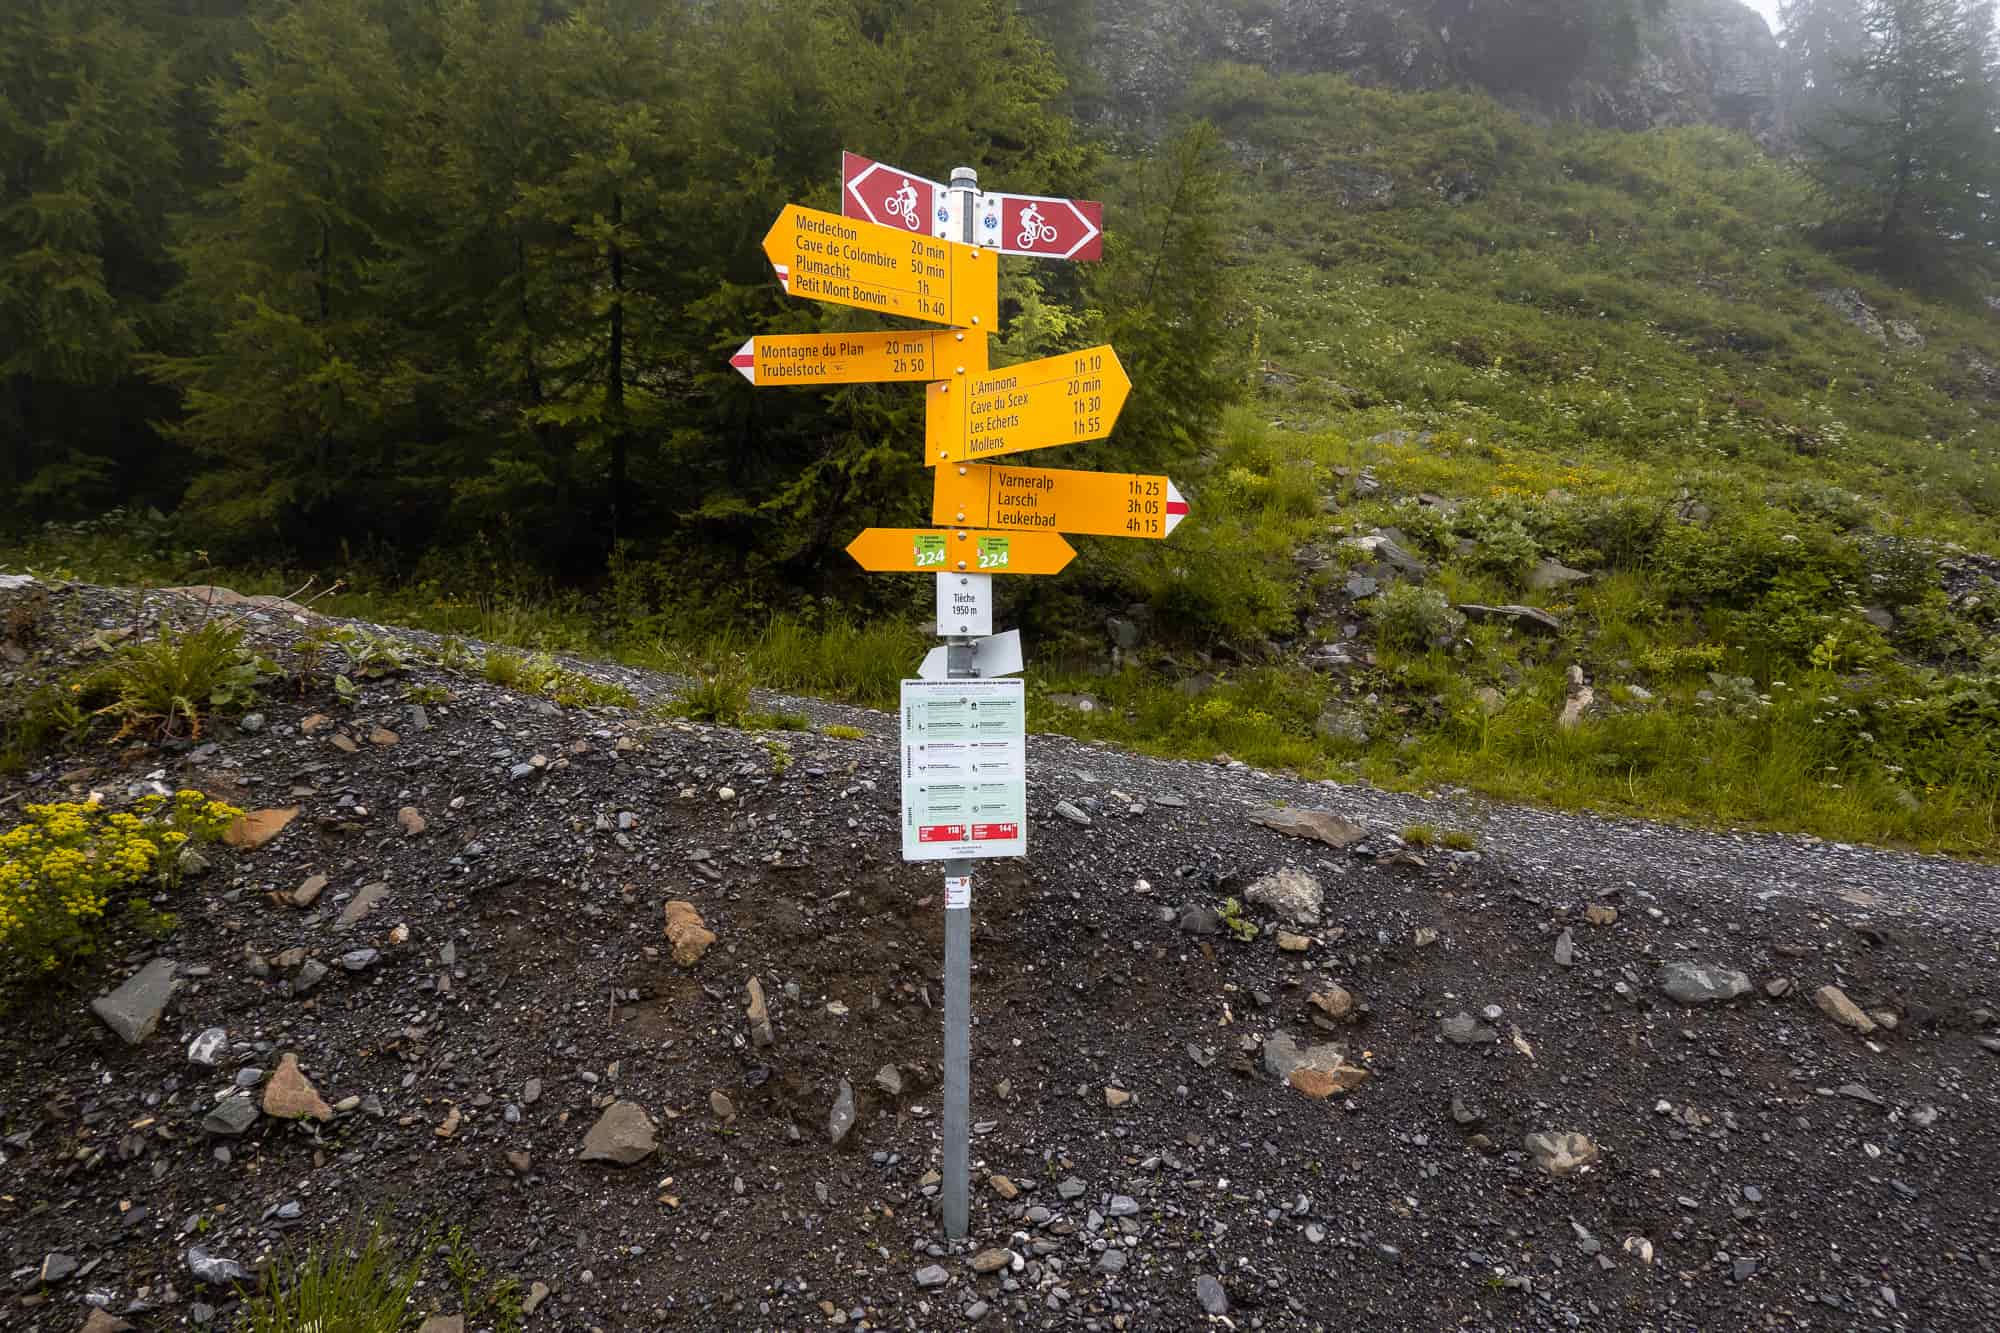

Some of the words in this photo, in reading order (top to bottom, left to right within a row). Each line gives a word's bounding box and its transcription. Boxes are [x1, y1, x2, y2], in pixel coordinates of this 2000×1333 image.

[796, 214, 857, 241] Merdechon
[912, 240, 923, 256] 20
[926, 246, 945, 260] min
[796, 235, 822, 252] Cave
[826, 240, 840, 256] de
[844, 245, 897, 269] Colombire
[912, 259, 923, 274] 50
[926, 266, 945, 279] min
[796, 255, 850, 279] Plumachit
[918, 280, 929, 295] 1h
[796, 275, 819, 292] Petit
[822, 280, 850, 299] Mont
[853, 286, 887, 305] Bonvin
[918, 299, 929, 313] 1h
[932, 302, 945, 316] 40
[761, 345, 818, 361] Montagne
[822, 343, 836, 357] du
[840, 342, 864, 356] Plan
[886, 340, 899, 354] 20
[903, 341, 924, 354] min
[761, 362, 826, 377] Trubelstock
[894, 359, 906, 373] 2h
[911, 358, 924, 372] 50
[971, 376, 1017, 396] L'Aminona
[1074, 359, 1086, 376] 1h
[1090, 355, 1101, 370] 10
[970, 400, 992, 414] Cave
[994, 396, 1005, 410] du
[1008, 393, 1029, 408] Scex
[1068, 380, 1080, 396] 20
[1082, 377, 1101, 393] min
[970, 420, 984, 434] Les
[986, 415, 1019, 432] Echerts
[1074, 399, 1085, 415] 1h
[1088, 396, 1100, 413] 30
[970, 436, 1004, 454] Mollens
[1074, 420, 1085, 435] 1h
[1088, 416, 1100, 433] 55
[1000, 473, 1054, 493] Varneralp
[1129, 481, 1142, 495] 1h
[1145, 482, 1160, 496] 25
[998, 492, 1038, 508] Larschi
[1127, 500, 1141, 513] 3h
[1144, 500, 1158, 514] 05
[996, 510, 1056, 527] Leukerbad
[1126, 518, 1140, 532] 4h
[1145, 520, 1158, 533] 15
[917, 548, 945, 566] 224
[979, 552, 1008, 568] 224
[952, 606, 969, 616] 1950
[970, 607, 978, 616] m
